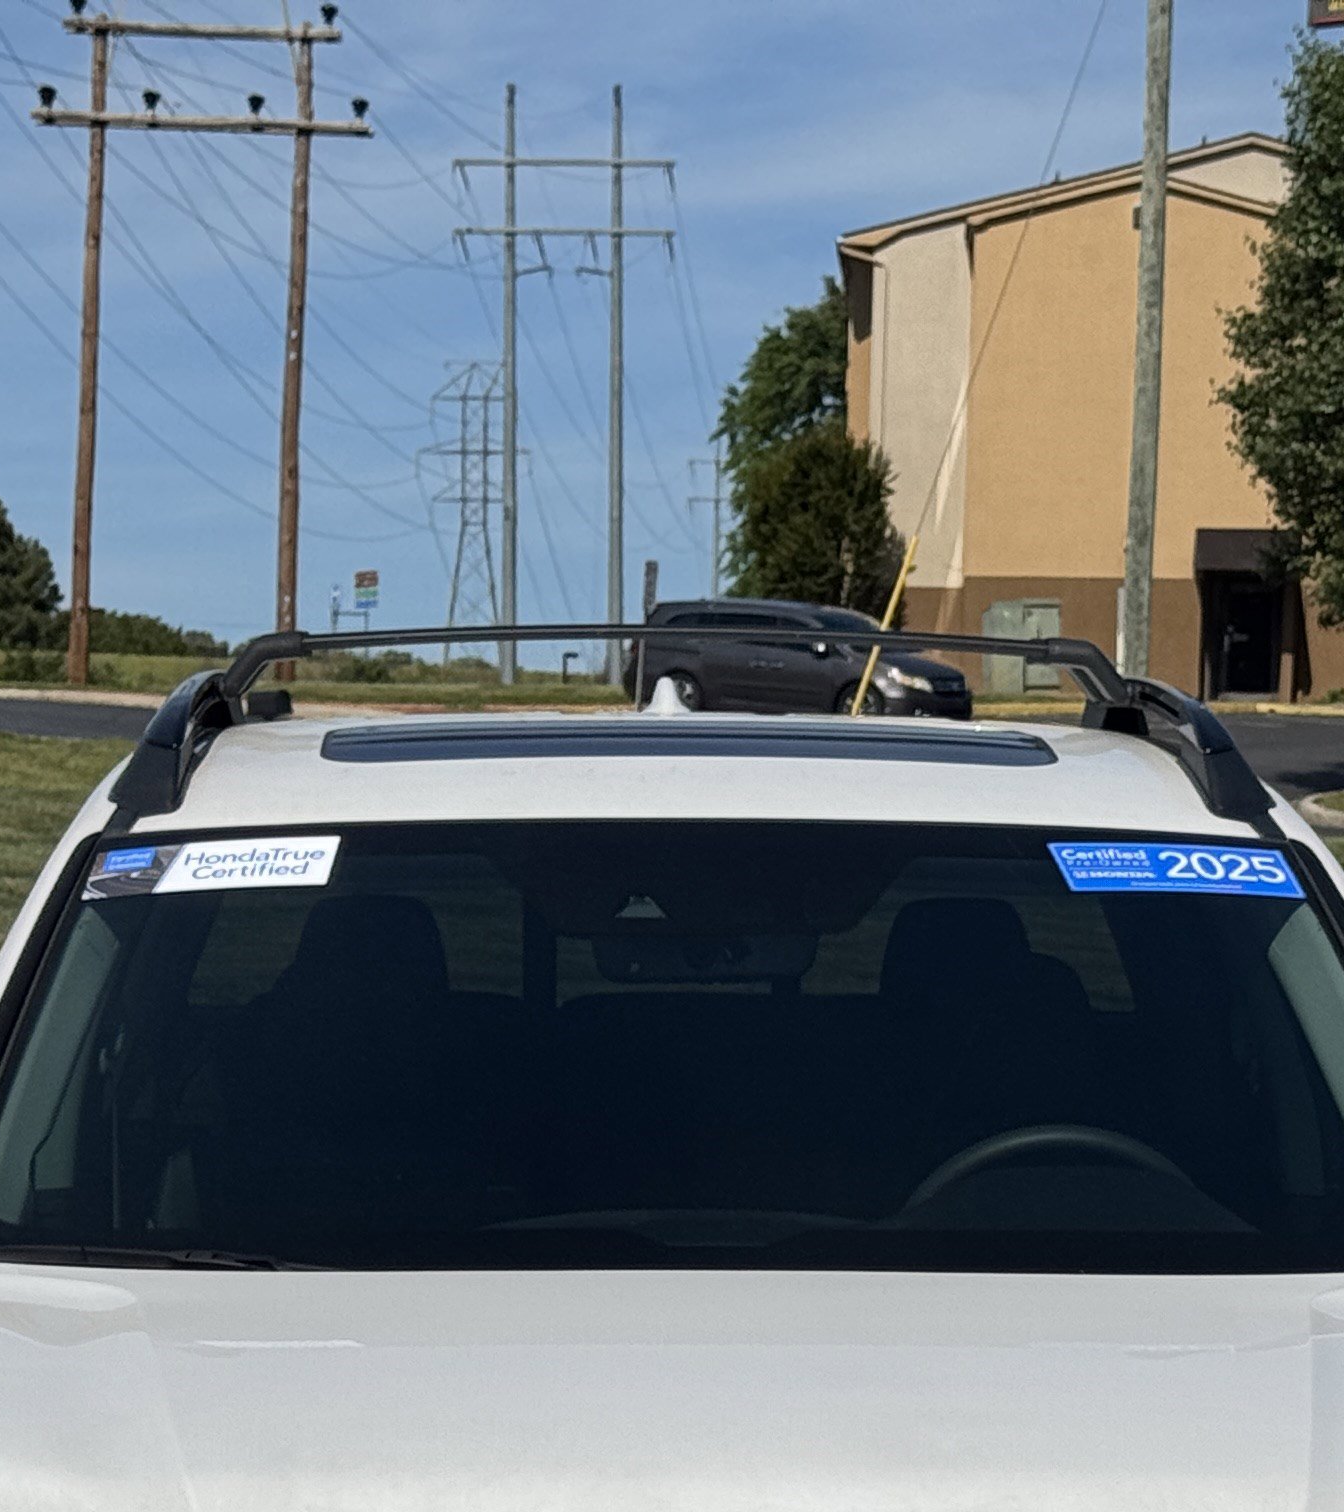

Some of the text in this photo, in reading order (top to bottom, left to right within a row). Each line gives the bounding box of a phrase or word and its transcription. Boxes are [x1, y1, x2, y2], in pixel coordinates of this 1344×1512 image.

[184, 847, 326, 866] HondaTrue
[1061, 848, 1147, 860] Certified
[191, 861, 310, 880] Certified
[1158, 851, 1287, 883] 2025
